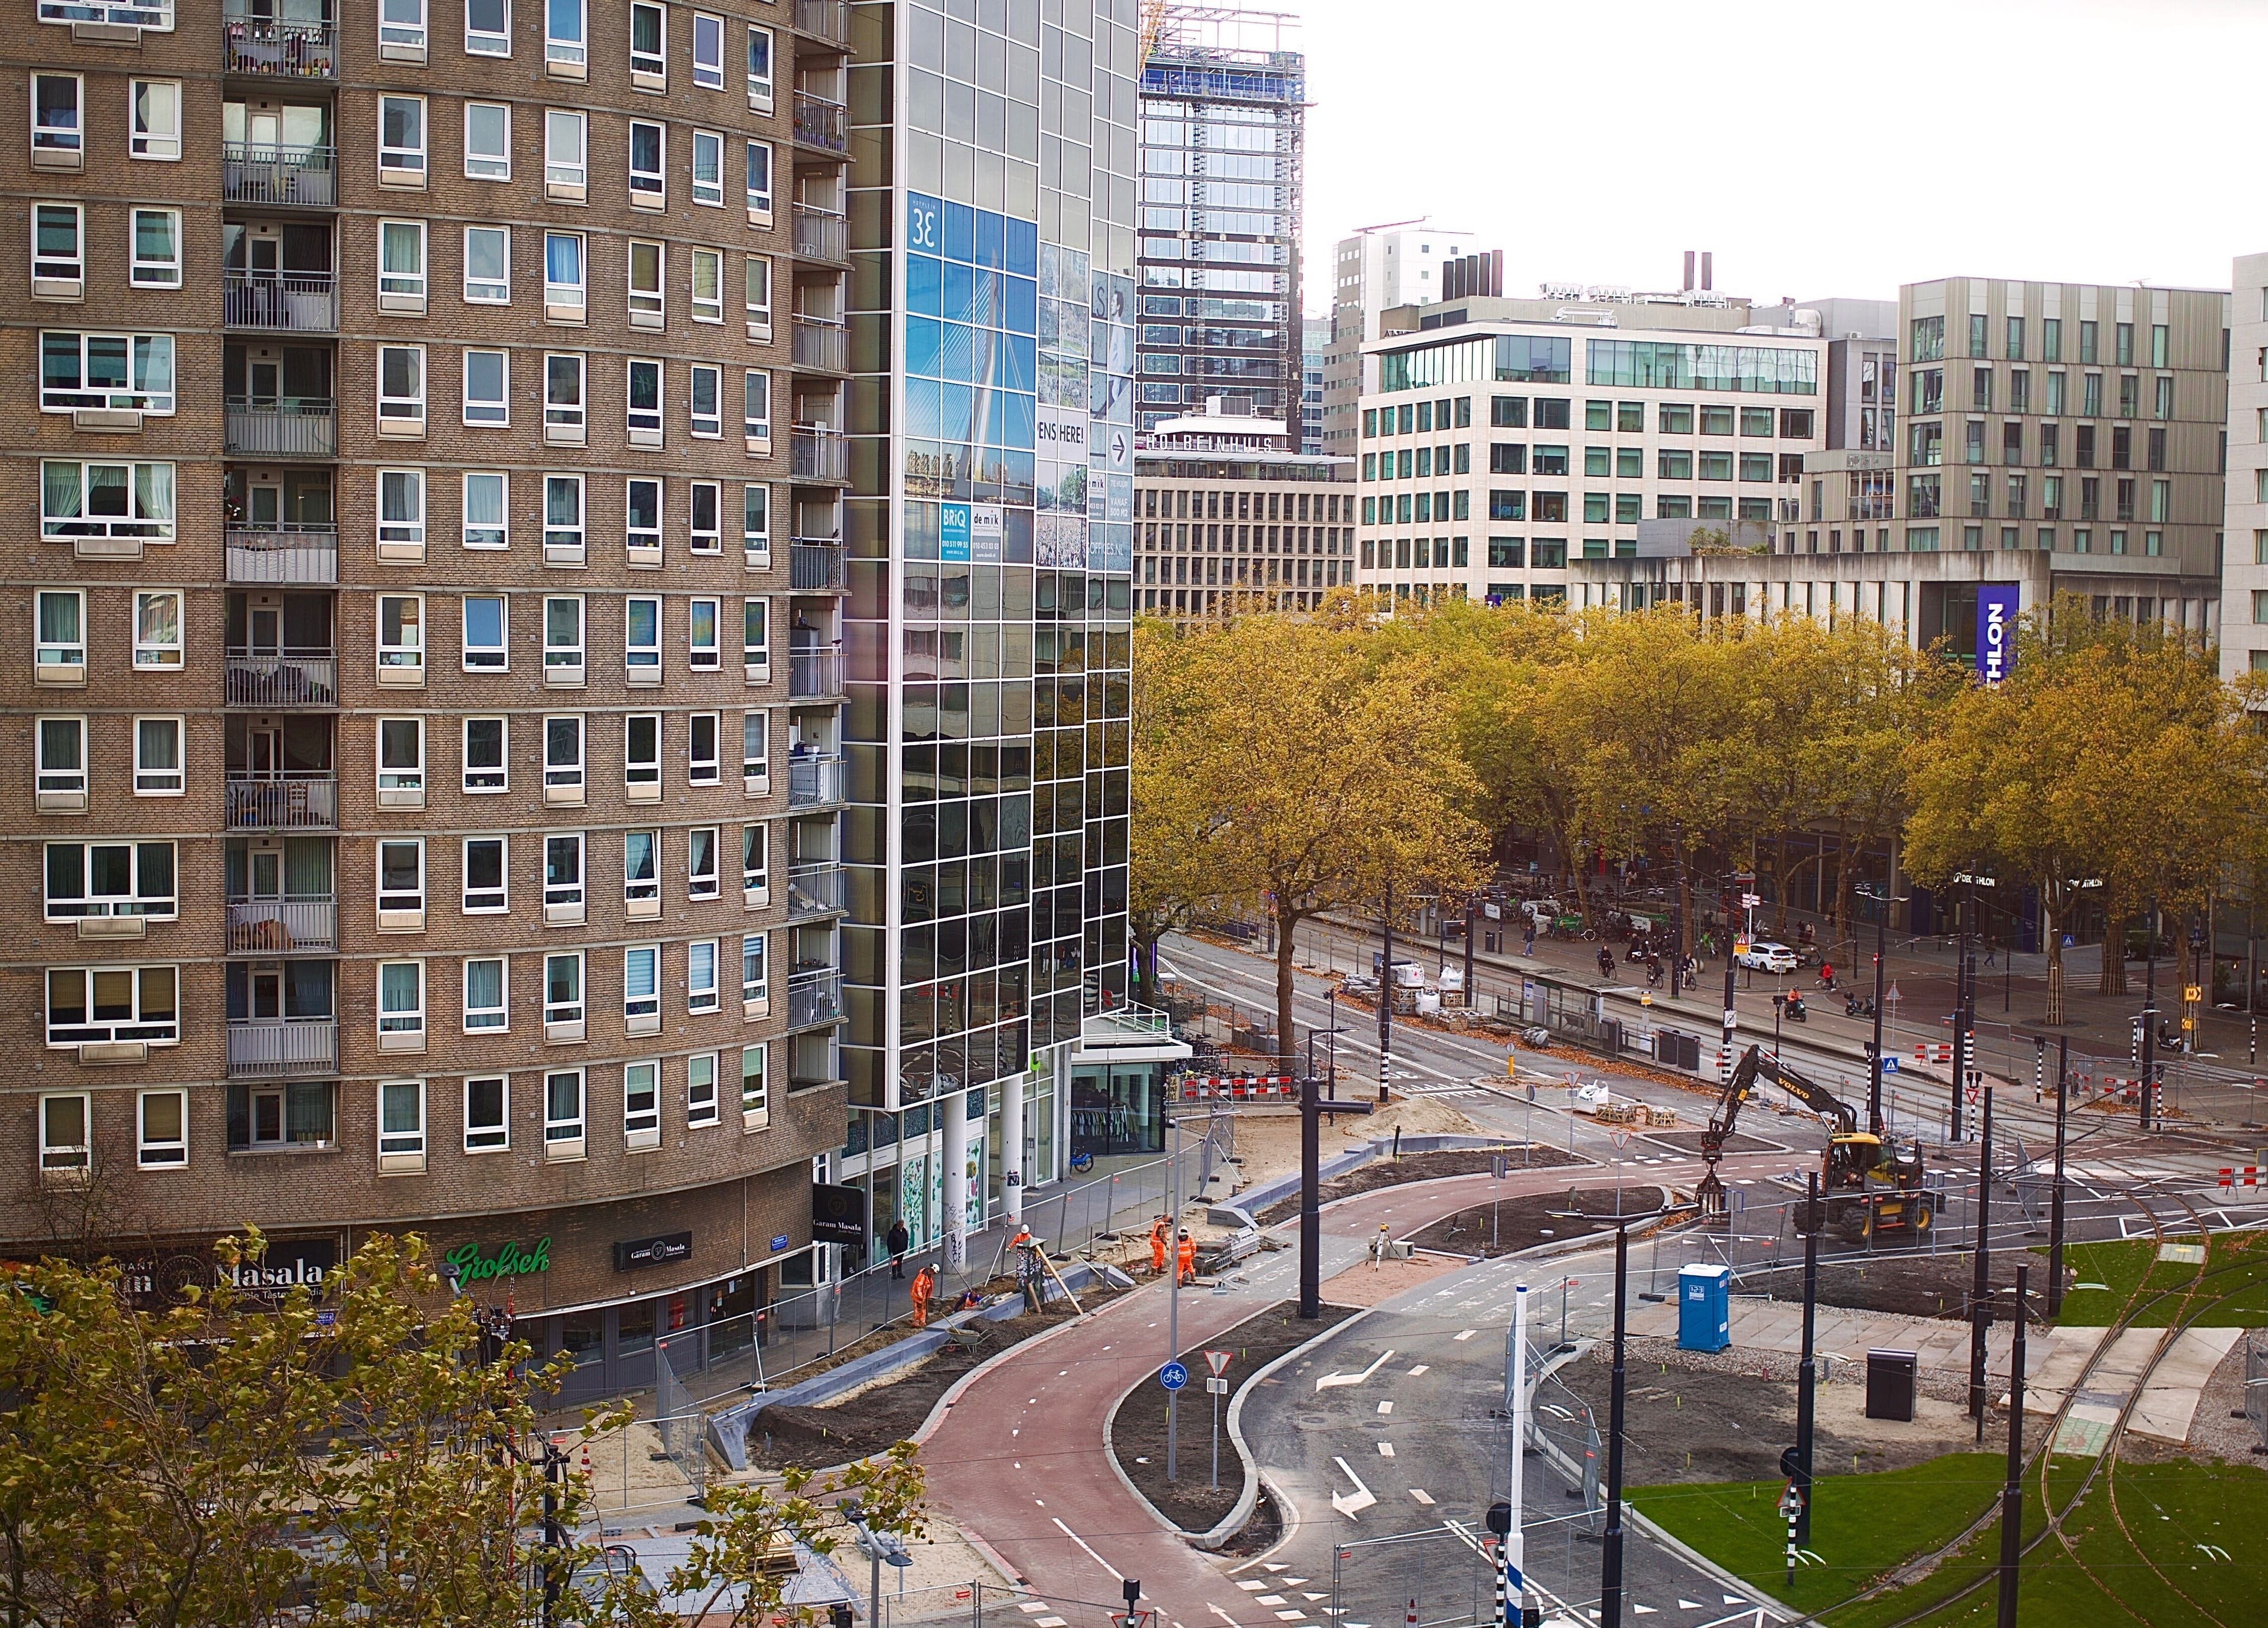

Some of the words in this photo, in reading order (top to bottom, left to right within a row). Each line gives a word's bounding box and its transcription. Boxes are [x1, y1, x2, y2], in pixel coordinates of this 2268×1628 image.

[1060, 424, 1084, 444] HERE!
[1146, 434, 1272, 453] HOLBEINHUIS
[1110, 497, 1128, 507] VANAF
[974, 513, 982, 524] de
[984, 510, 999, 525] mik
[1110, 508, 1120, 516] 500
[1089, 542, 1124, 556] OFFICES.NL
[1778, 1077, 1810, 1099] VOLVO
[813, 1219, 836, 1228] Garam
[838, 1222, 861, 1231] Masala
[631, 1251, 650, 1259] Garam
[666, 1243, 685, 1252] Masala
[446, 1237, 551, 1288] Grolsch
